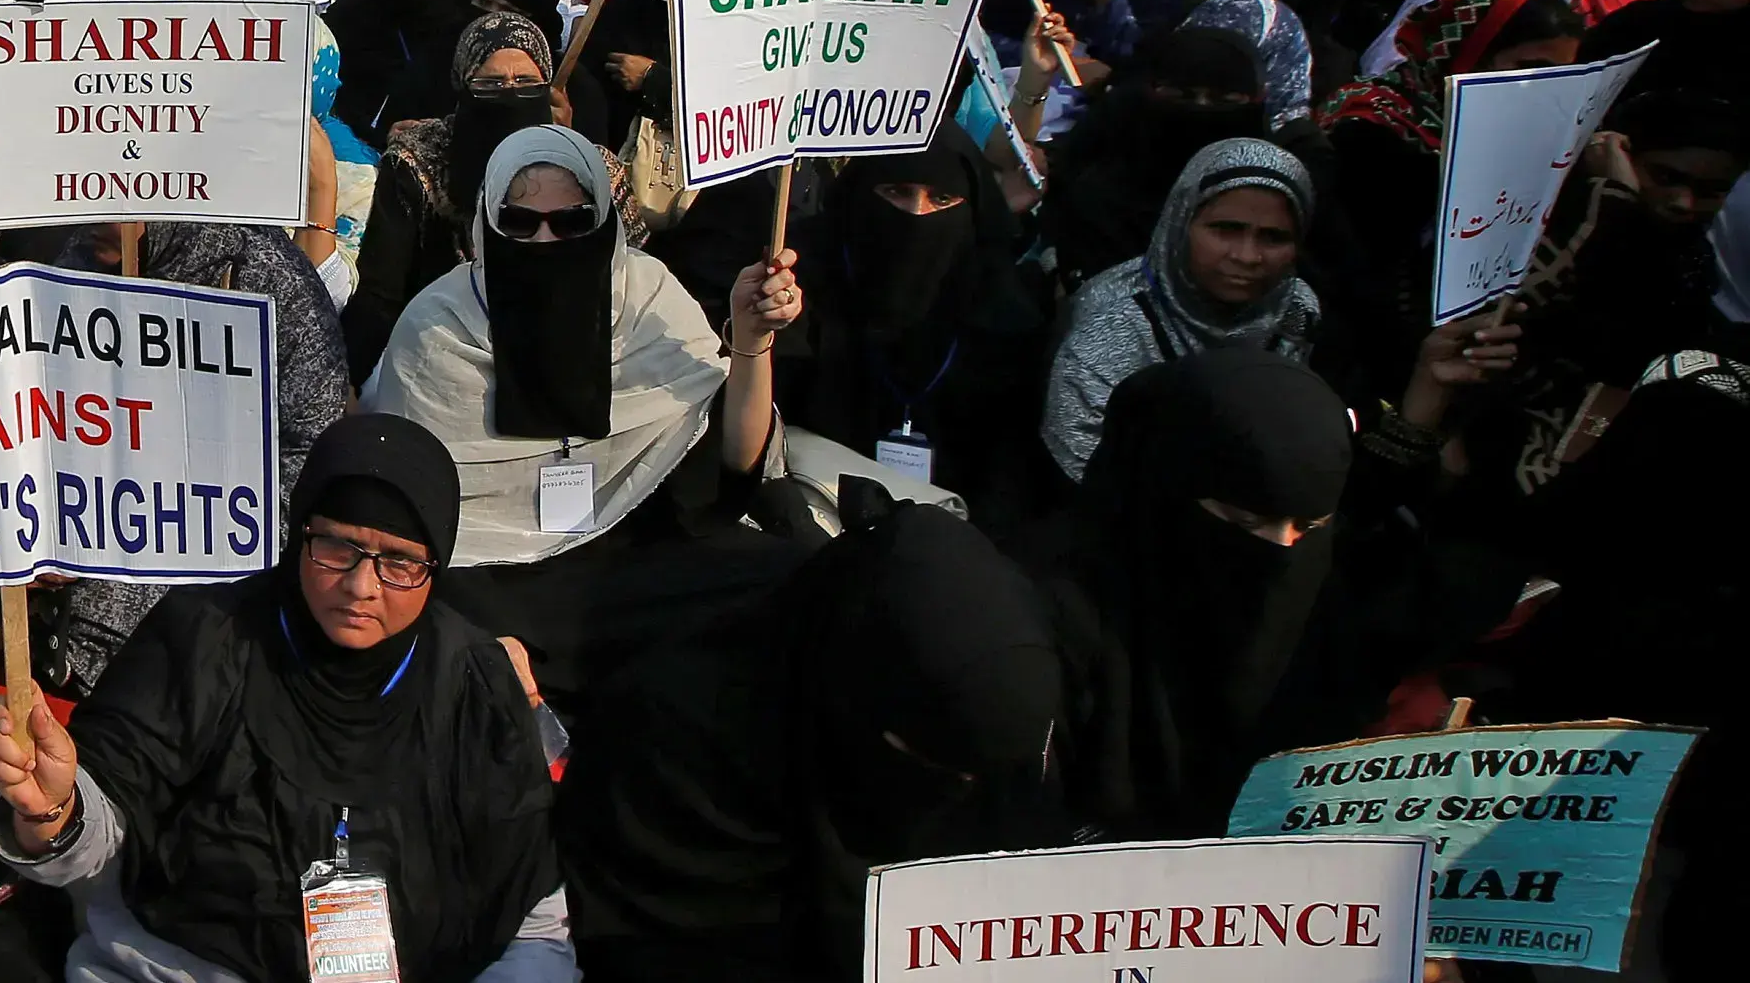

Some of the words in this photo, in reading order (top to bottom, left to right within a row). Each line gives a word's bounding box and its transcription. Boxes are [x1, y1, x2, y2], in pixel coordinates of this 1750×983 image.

[820, 21, 868, 65] US
[72, 73, 155, 95] GIVES
[160, 72, 194, 95] US
[54, 103, 211, 135] DIGNITY
[694, 94, 784, 166] DIGNITY
[800, 88, 931, 140] HONOUR
[121, 139, 142, 161] &
[53, 171, 211, 203] HONOUR
[137, 313, 254, 379] BILL
[55, 472, 263, 557] RIGHTS
[1292, 750, 1462, 789] MUSLIM
[1469, 748, 1645, 779] WOMEN
[1281, 797, 1389, 832] SAFE
[1394, 797, 1432, 822] &
[1436, 793, 1618, 823] SECURE
[905, 903, 1383, 972] INTERFERENCE
[1497, 926, 1583, 954] REACH
[316, 951, 390, 976] VOLUNTEER
